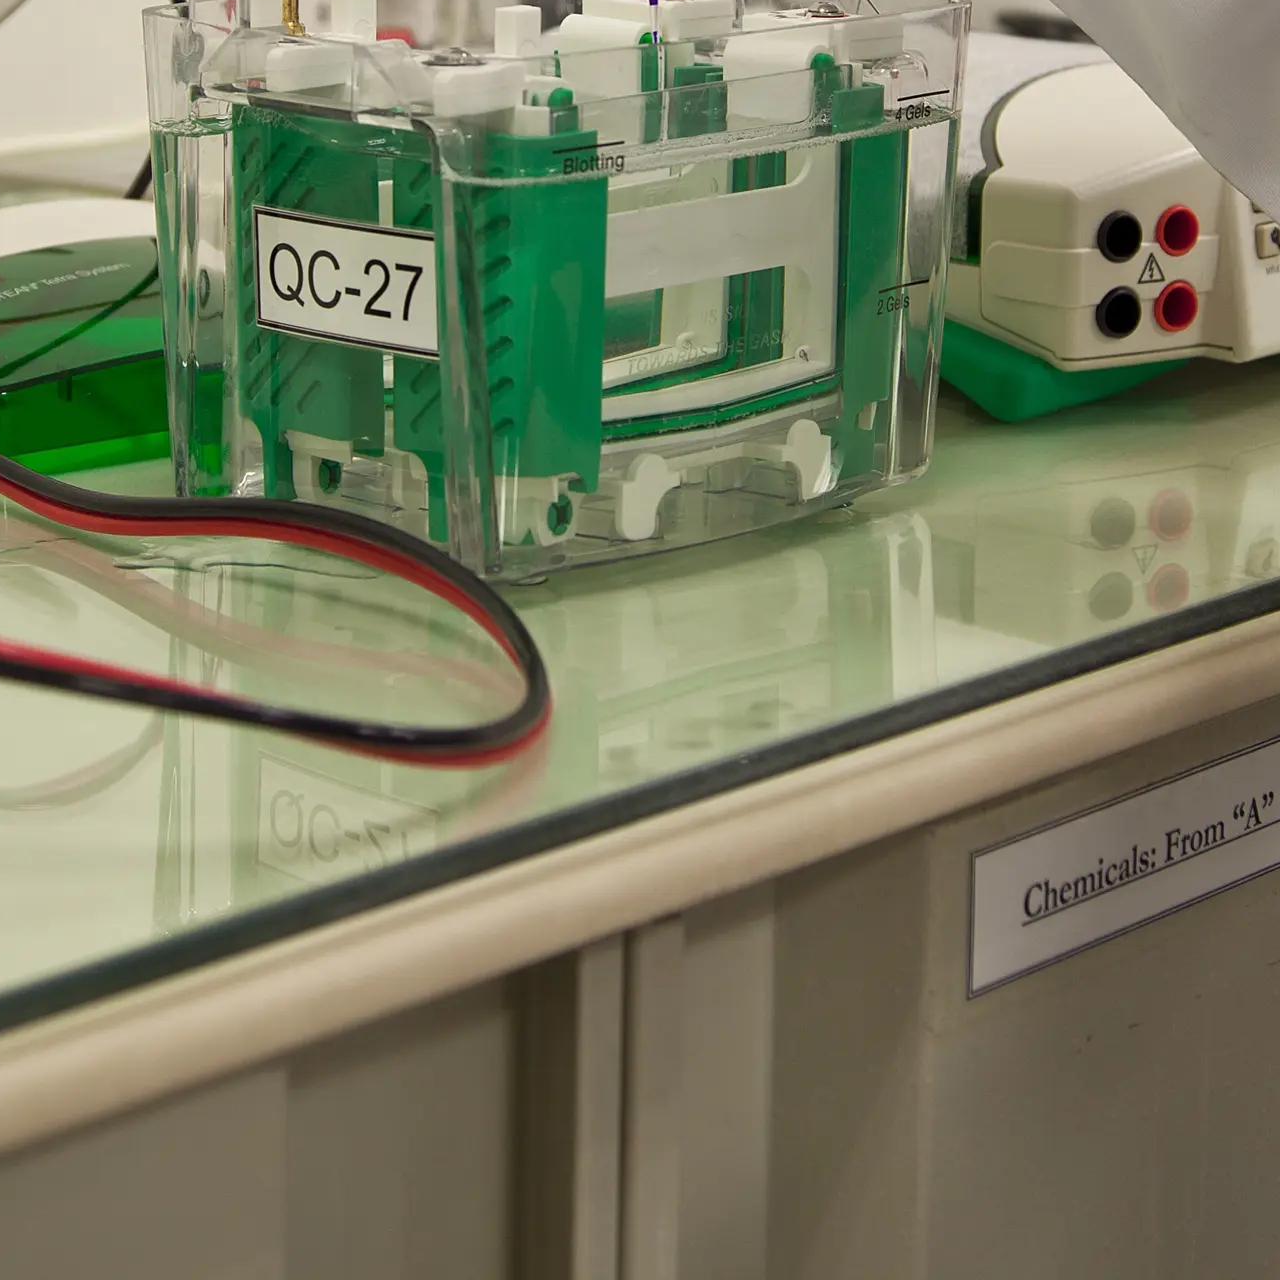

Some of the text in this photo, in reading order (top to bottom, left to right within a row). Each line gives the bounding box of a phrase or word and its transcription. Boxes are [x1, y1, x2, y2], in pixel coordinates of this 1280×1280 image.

[895, 103, 932, 122] 4 Gels
[563, 154, 625, 175] Blotting
[269, 242, 423, 321] QC-27
[877, 294, 910, 316] 2 Gels
[1023, 844, 1157, 918] Chemicals:
[1165, 820, 1226, 864] From
